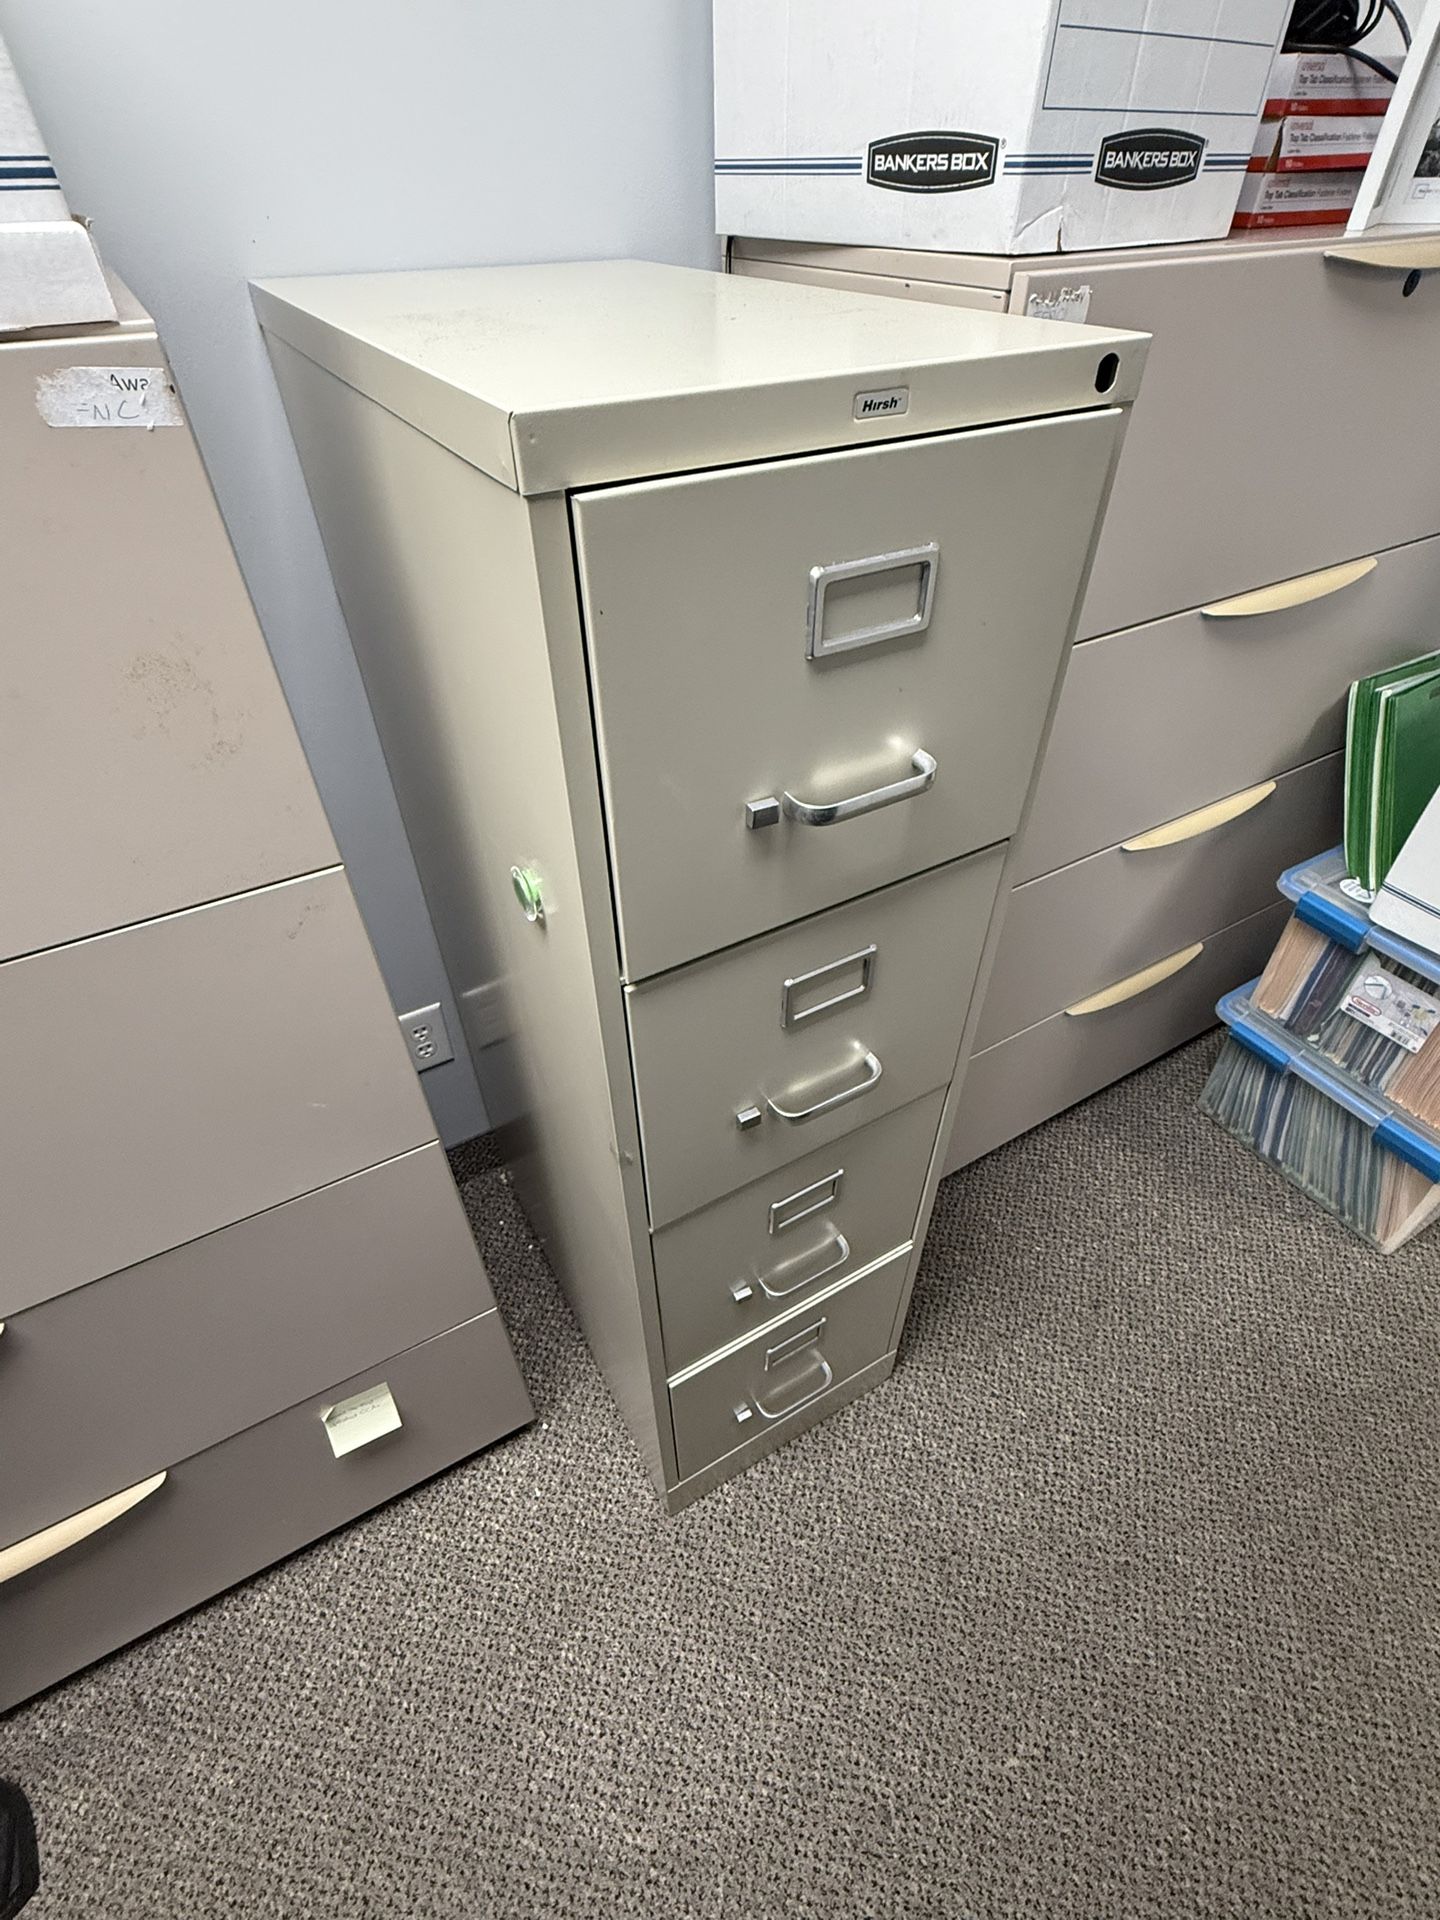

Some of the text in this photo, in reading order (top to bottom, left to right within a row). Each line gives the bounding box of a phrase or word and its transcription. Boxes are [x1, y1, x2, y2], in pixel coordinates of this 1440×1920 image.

[874, 152, 990, 173] BANKERS BOX
[1104, 150, 1198, 170] BANKERS BOX
[862, 396, 899, 412] Hirsh
